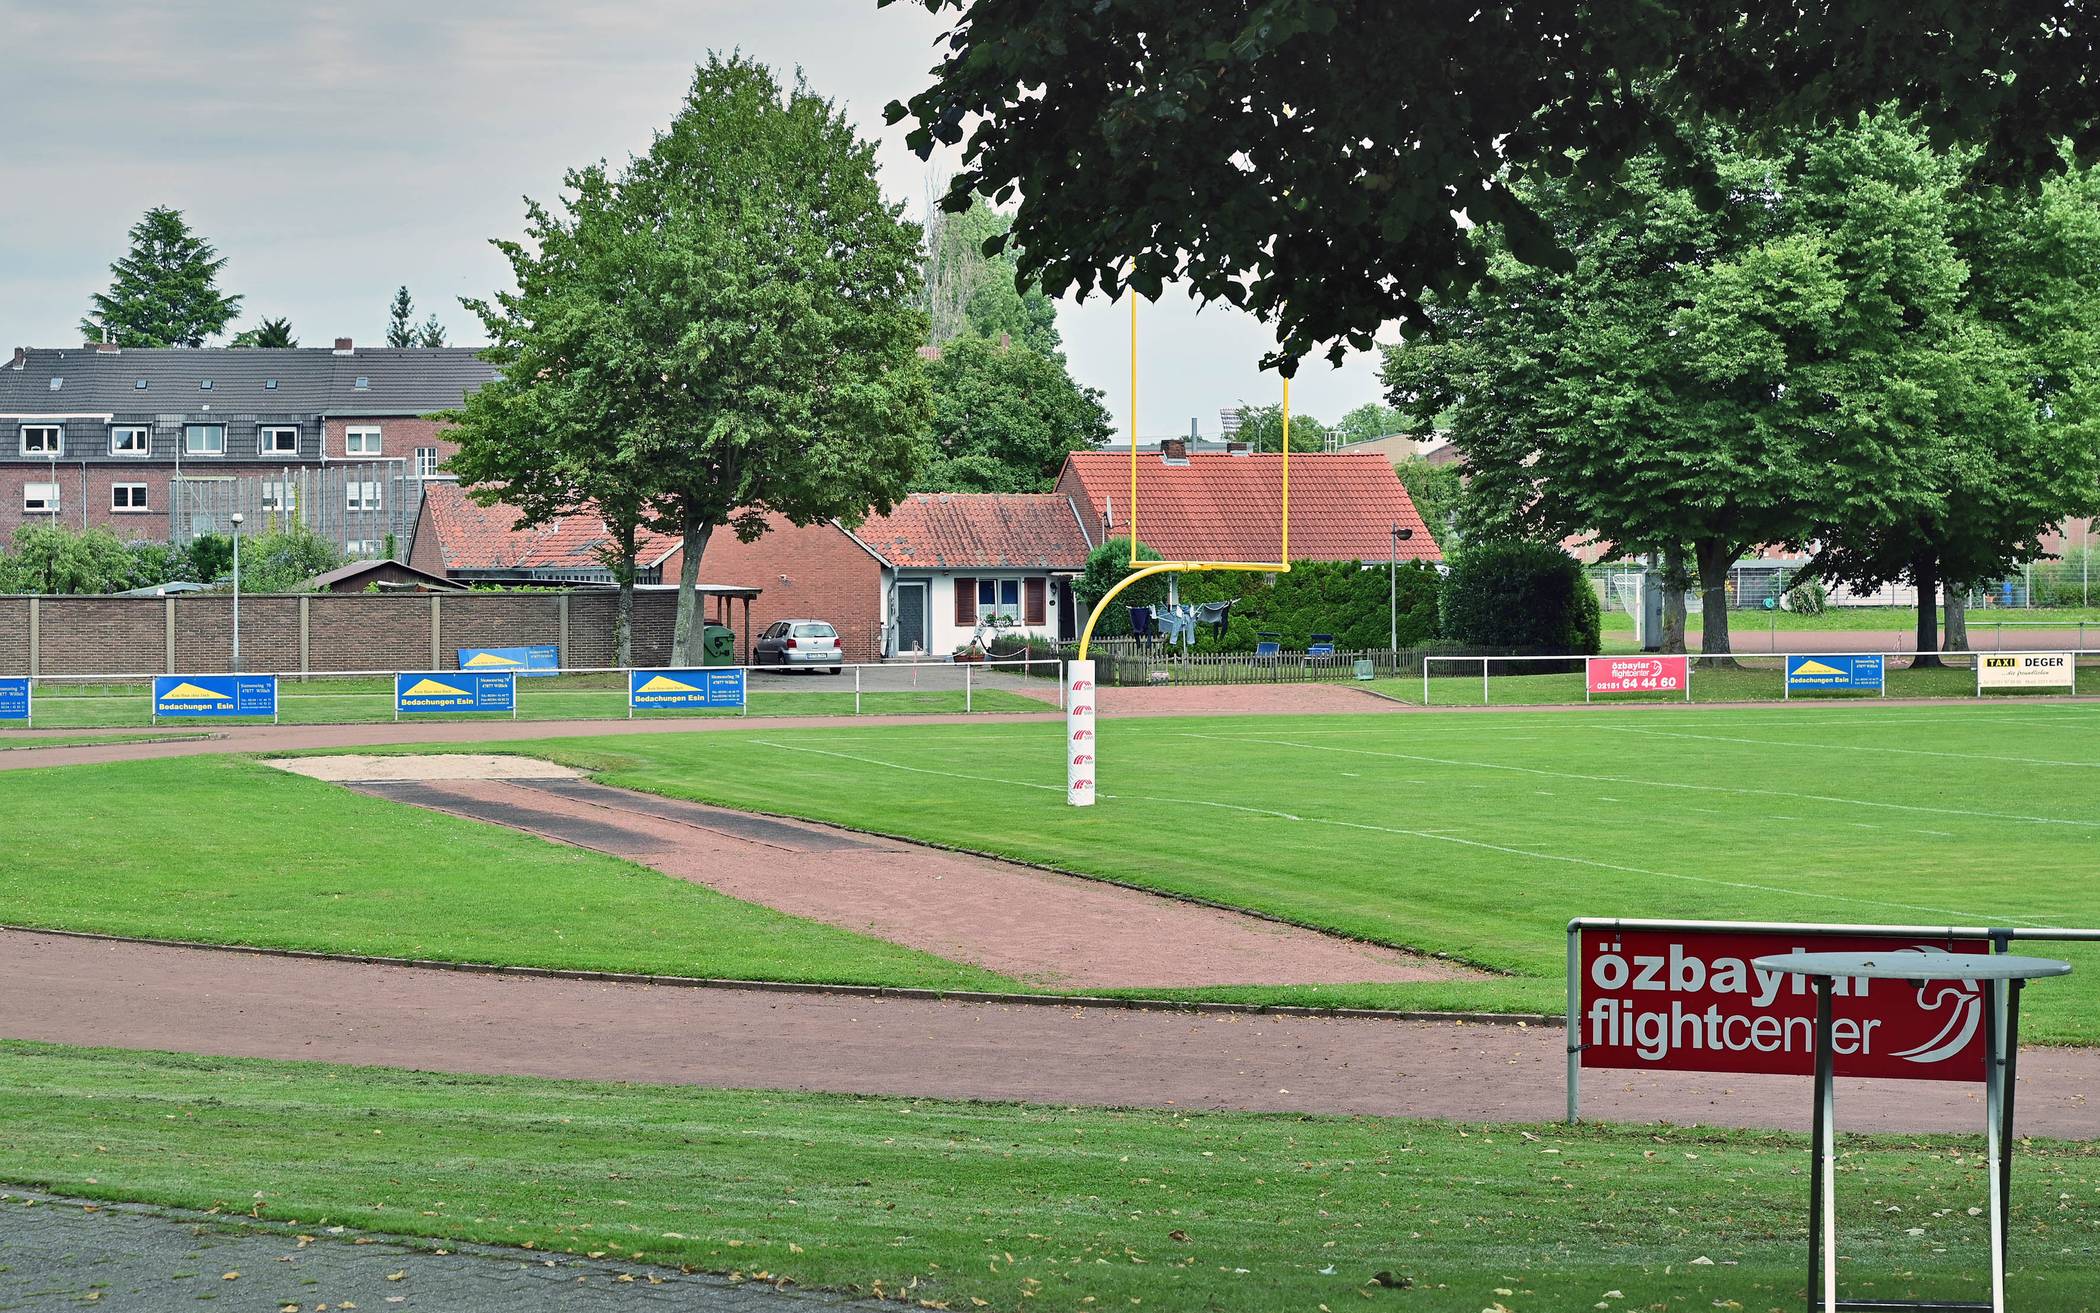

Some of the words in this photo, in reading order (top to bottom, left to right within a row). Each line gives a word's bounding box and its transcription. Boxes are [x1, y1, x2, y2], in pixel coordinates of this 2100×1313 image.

[1612, 662, 1650, 670] özbaylar
[1988, 658, 2014, 666] TAXI
[2025, 658, 2064, 666] DEGER
[1612, 670, 1650, 678] flightcenter
[1623, 678, 1637, 688] 64
[1642, 678, 1656, 688] 44
[1661, 677, 1676, 687] 60
[159, 703, 212, 711] Bedachungen
[1588, 998, 1882, 1060] flightcener
